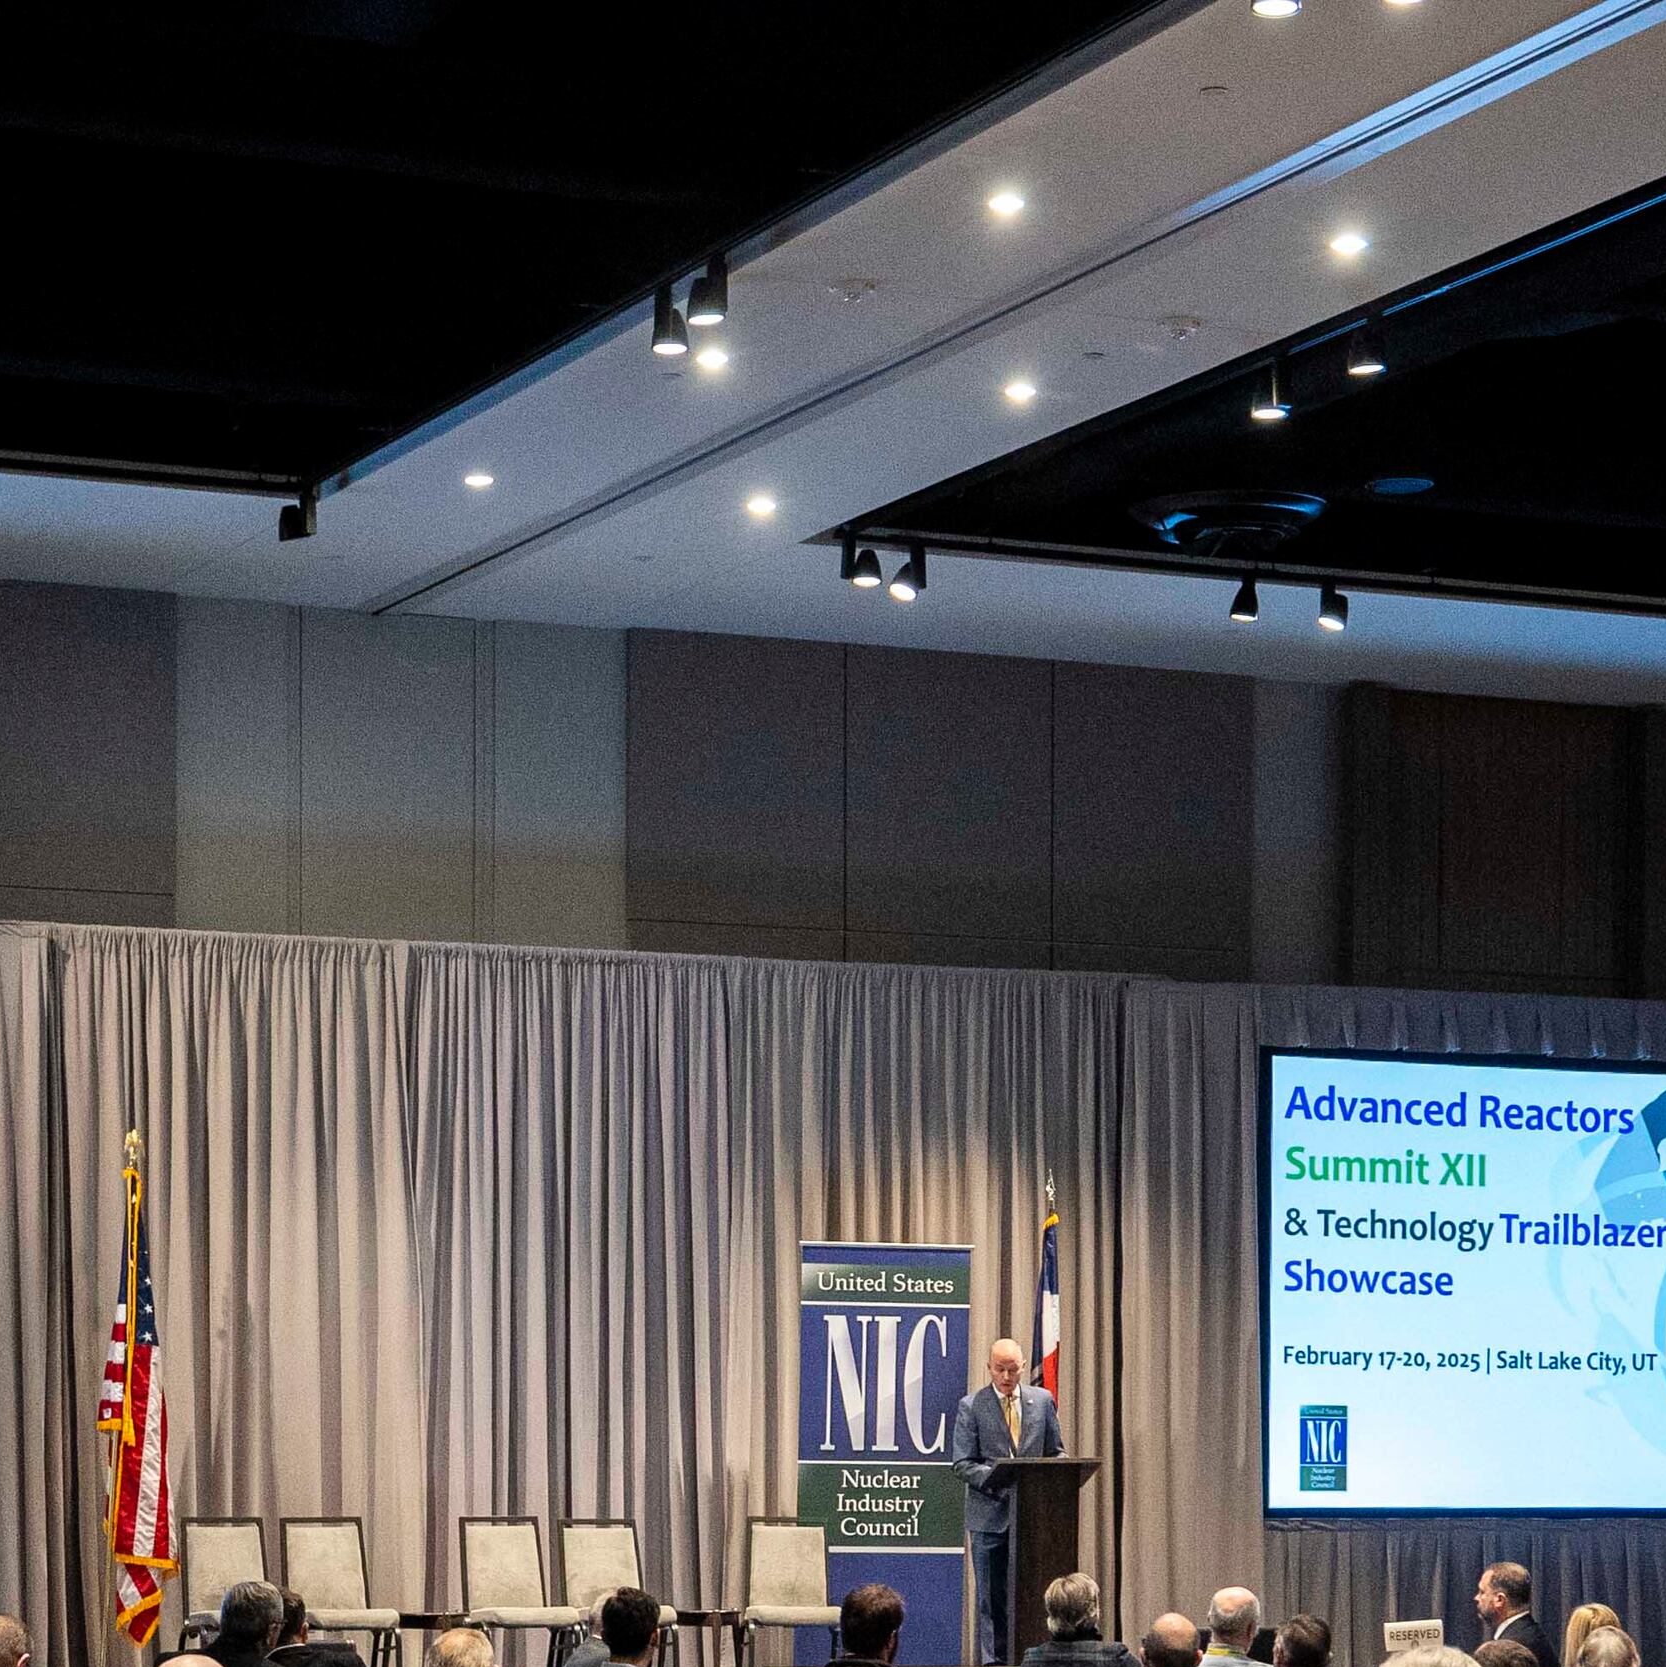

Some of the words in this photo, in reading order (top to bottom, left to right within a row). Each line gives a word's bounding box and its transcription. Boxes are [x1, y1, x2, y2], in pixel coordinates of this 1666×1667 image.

[1285, 1085, 1467, 1128] Advanced
[1479, 1094, 1634, 1134] Reactors
[1285, 1145, 1430, 1185] Summit
[1439, 1153, 1487, 1187] XII
[1284, 1208, 1309, 1237] &
[1316, 1208, 1494, 1252] Technology
[817, 1271, 887, 1293] United
[893, 1273, 954, 1295] States
[1283, 1260, 1454, 1297] Showcase
[1283, 1344, 1373, 1371] February
[1379, 1351, 1431, 1372] 17-20,
[1437, 1352, 1481, 1373] 2025
[1496, 1349, 1533, 1370] Salt
[1537, 1351, 1582, 1371] Lake
[1586, 1351, 1628, 1377] City,
[1632, 1353, 1659, 1372] UT
[820, 1313, 947, 1455] NIC
[1306, 1420, 1342, 1463] NIC
[841, 1469, 921, 1489] Nuclear
[836, 1493, 925, 1516] Industry
[840, 1516, 920, 1538] Council
[1389, 1628, 1441, 1641] RESERVED
